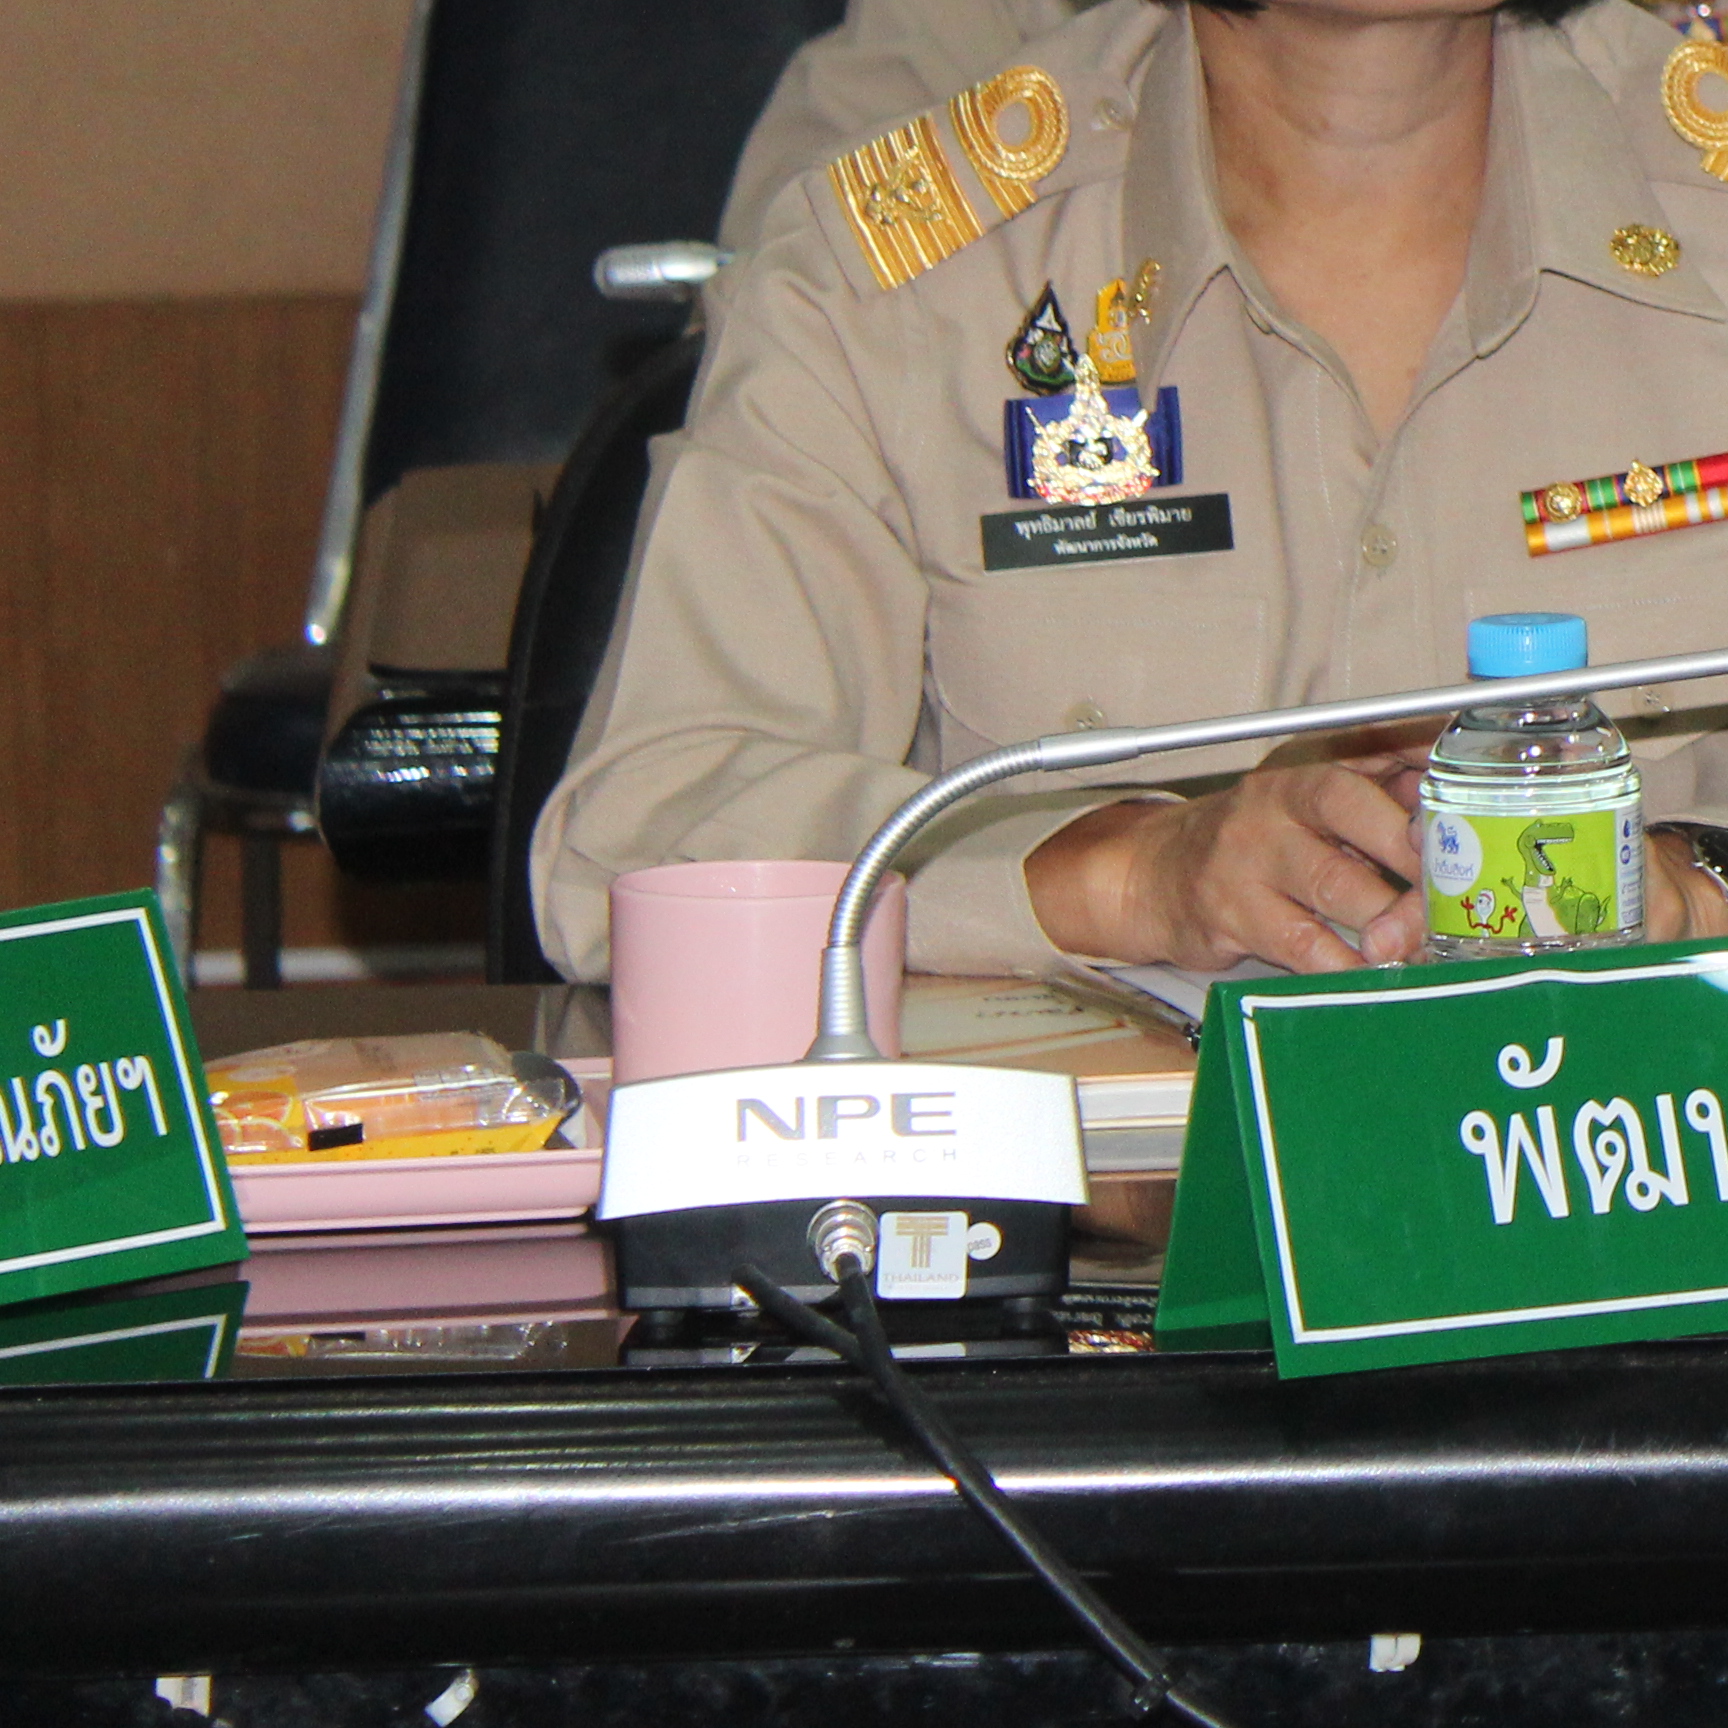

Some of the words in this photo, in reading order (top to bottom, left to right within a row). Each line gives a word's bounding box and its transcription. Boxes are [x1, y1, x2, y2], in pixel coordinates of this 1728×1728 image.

[736, 1092, 957, 1143] NPE
[738, 1148, 957, 1168] RESEARCH
[883, 1273, 960, 1284] THAILAND
